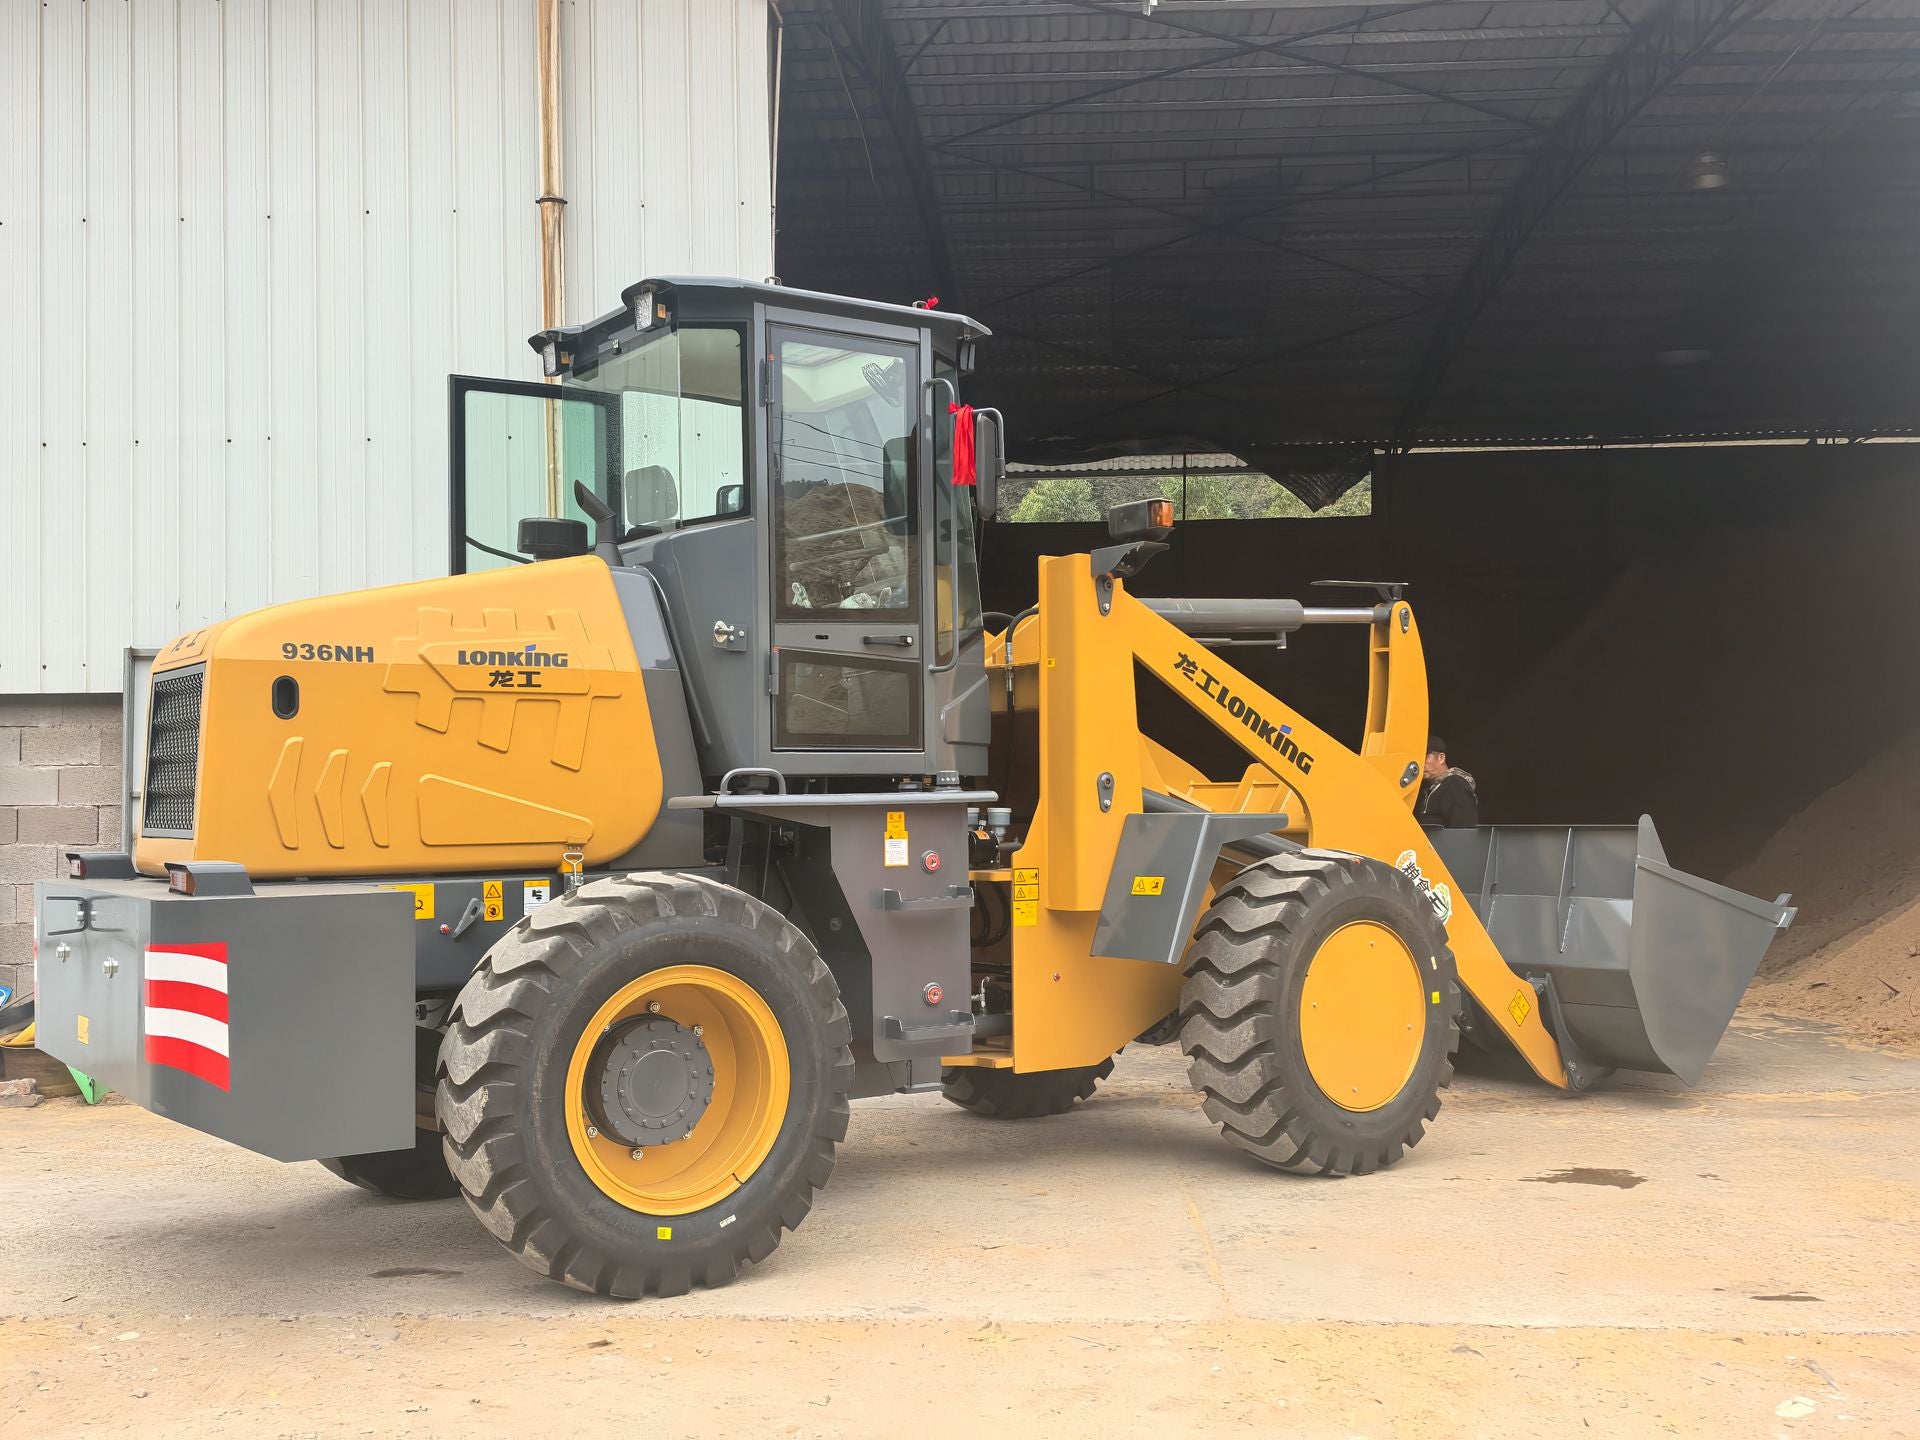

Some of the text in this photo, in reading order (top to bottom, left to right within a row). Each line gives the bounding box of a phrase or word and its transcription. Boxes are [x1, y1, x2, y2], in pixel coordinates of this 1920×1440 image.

[282, 642, 374, 663] 936NH
[457, 644, 568, 667] LONKING
[488, 670, 542, 688] 龙工
[1173, 651, 1220, 699] 龙工
